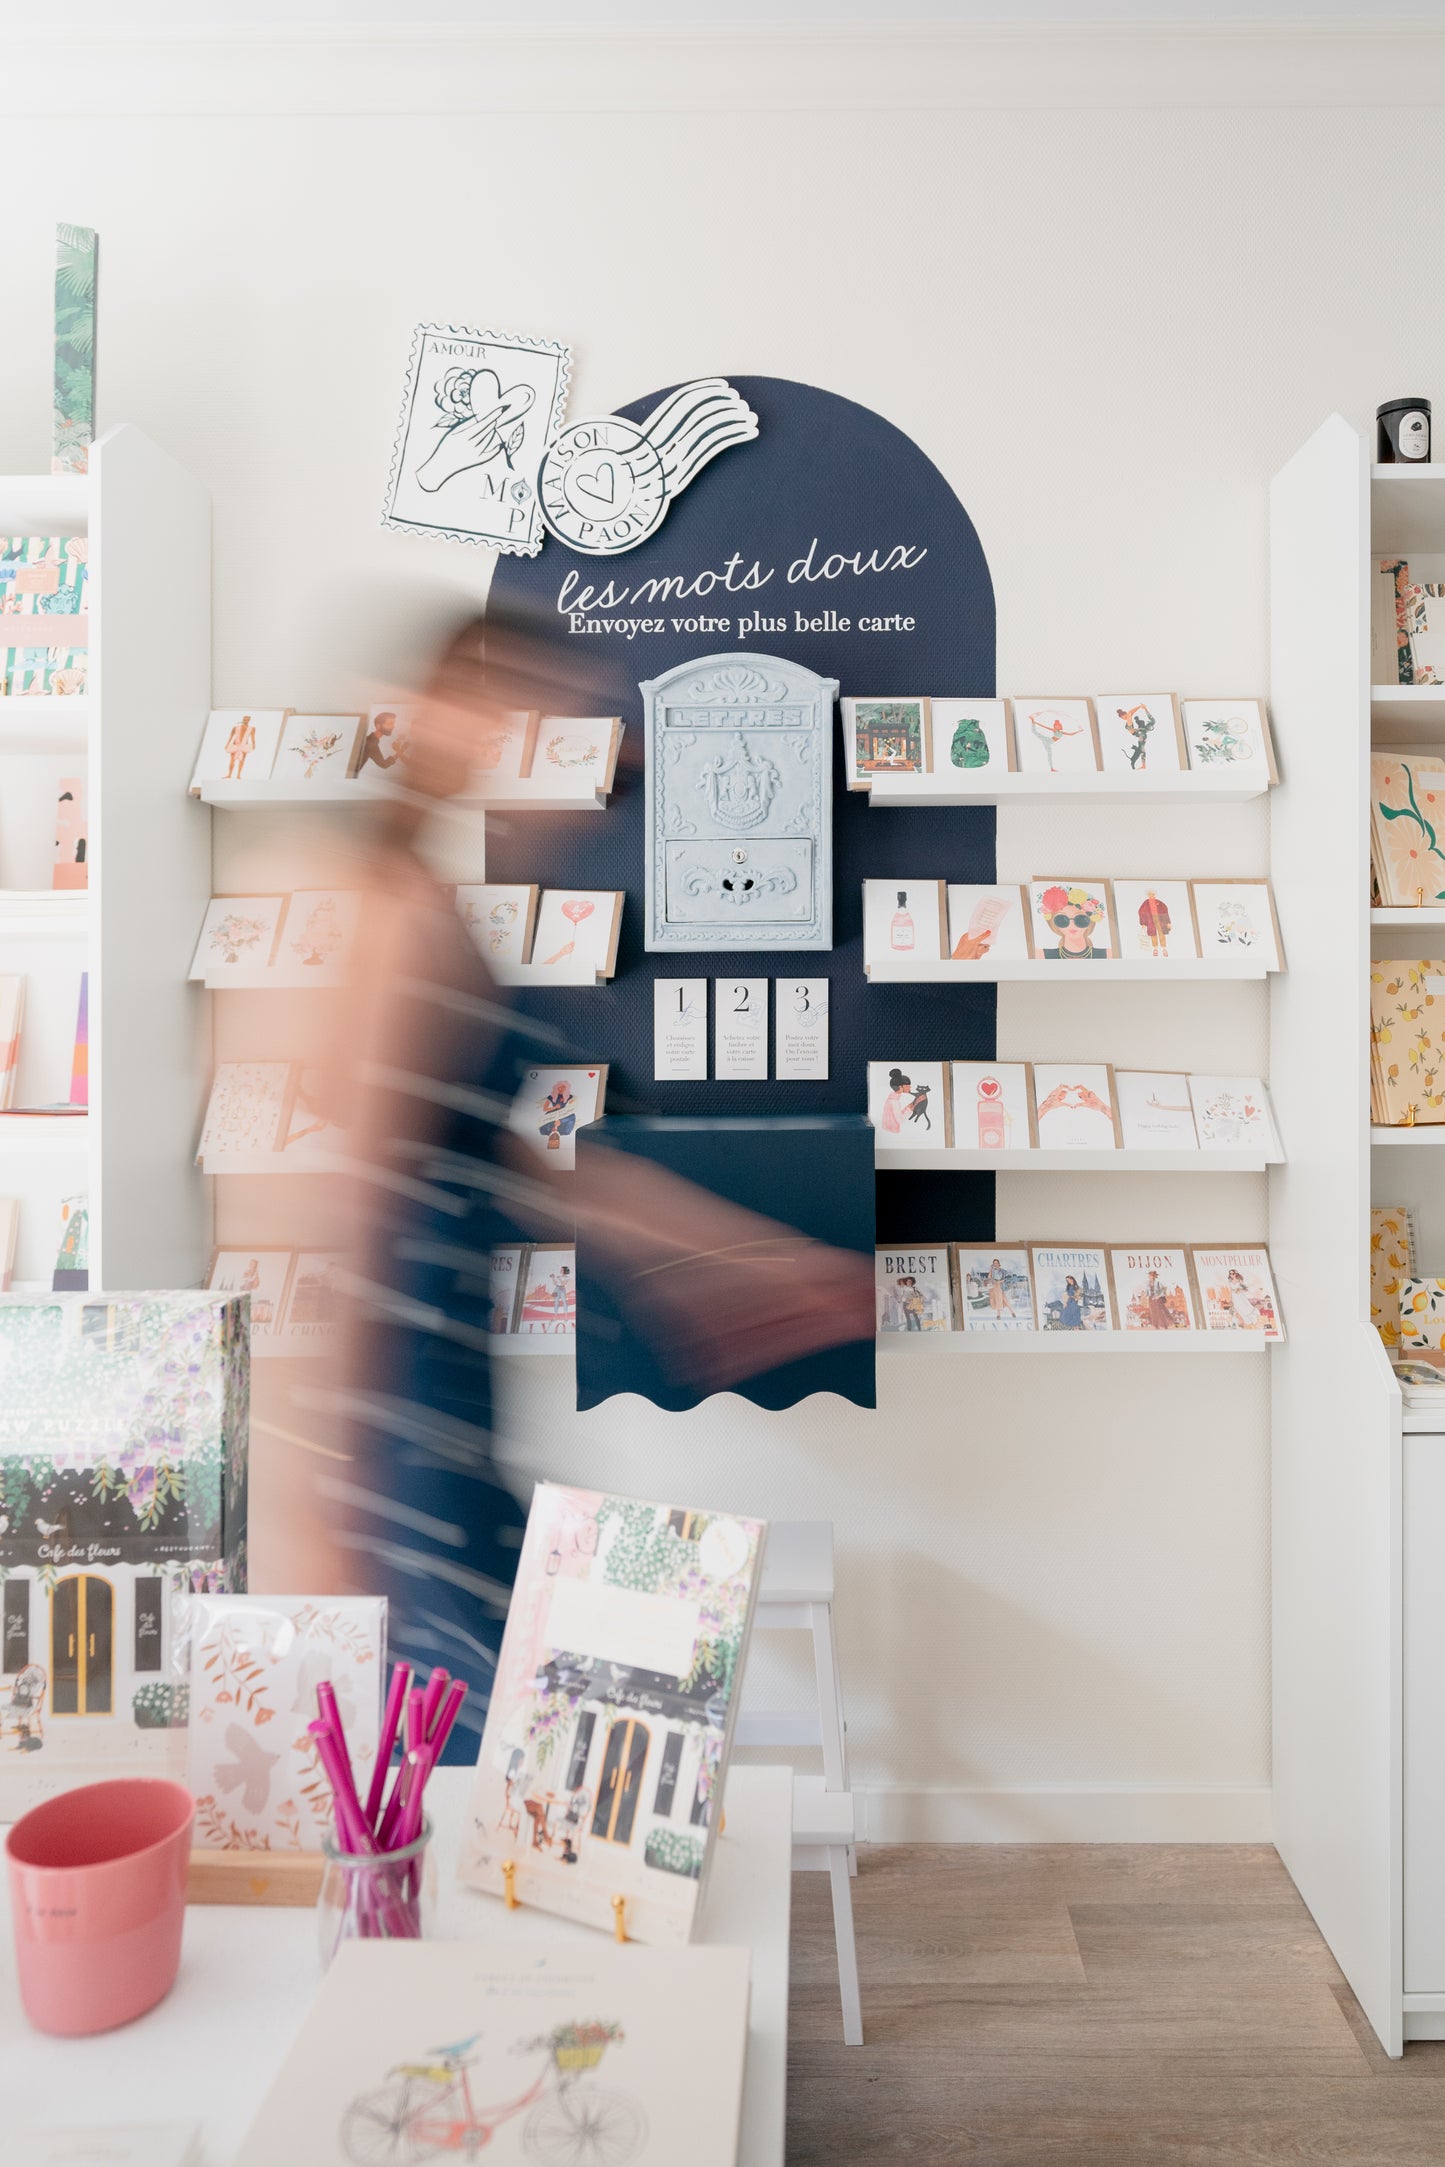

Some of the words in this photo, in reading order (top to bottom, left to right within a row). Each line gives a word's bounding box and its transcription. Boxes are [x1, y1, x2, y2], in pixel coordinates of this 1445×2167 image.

[428, 342, 487, 360] AMOUR
[546, 426, 610, 521] MAISON
[481, 473, 509, 503] M
[507, 507, 526, 534] P
[578, 503, 651, 544] PAON
[556, 570, 630, 615] les
[630, 551, 775, 606] mots
[787, 538, 928, 584] doux
[568, 612, 666, 639] Envoyez
[674, 615, 730, 633] votre
[738, 612, 787, 639] plus
[794, 610, 851, 633] belle
[858, 613, 916, 633] carte
[673, 708, 804, 728] LETTRES
[674, 986, 686, 1013] 1
[733, 985, 750, 1012] 2
[793, 985, 810, 1012] 3
[530, 1072, 538, 1080] Q
[885, 1256, 937, 1274] BREST
[1037, 1253, 1100, 1268] CHARTRES
[1127, 1255, 1174, 1269] DIJON
[1200, 1254, 1263, 1268] MONTPELLIER
[87, 1543, 121, 1562] fleurs
